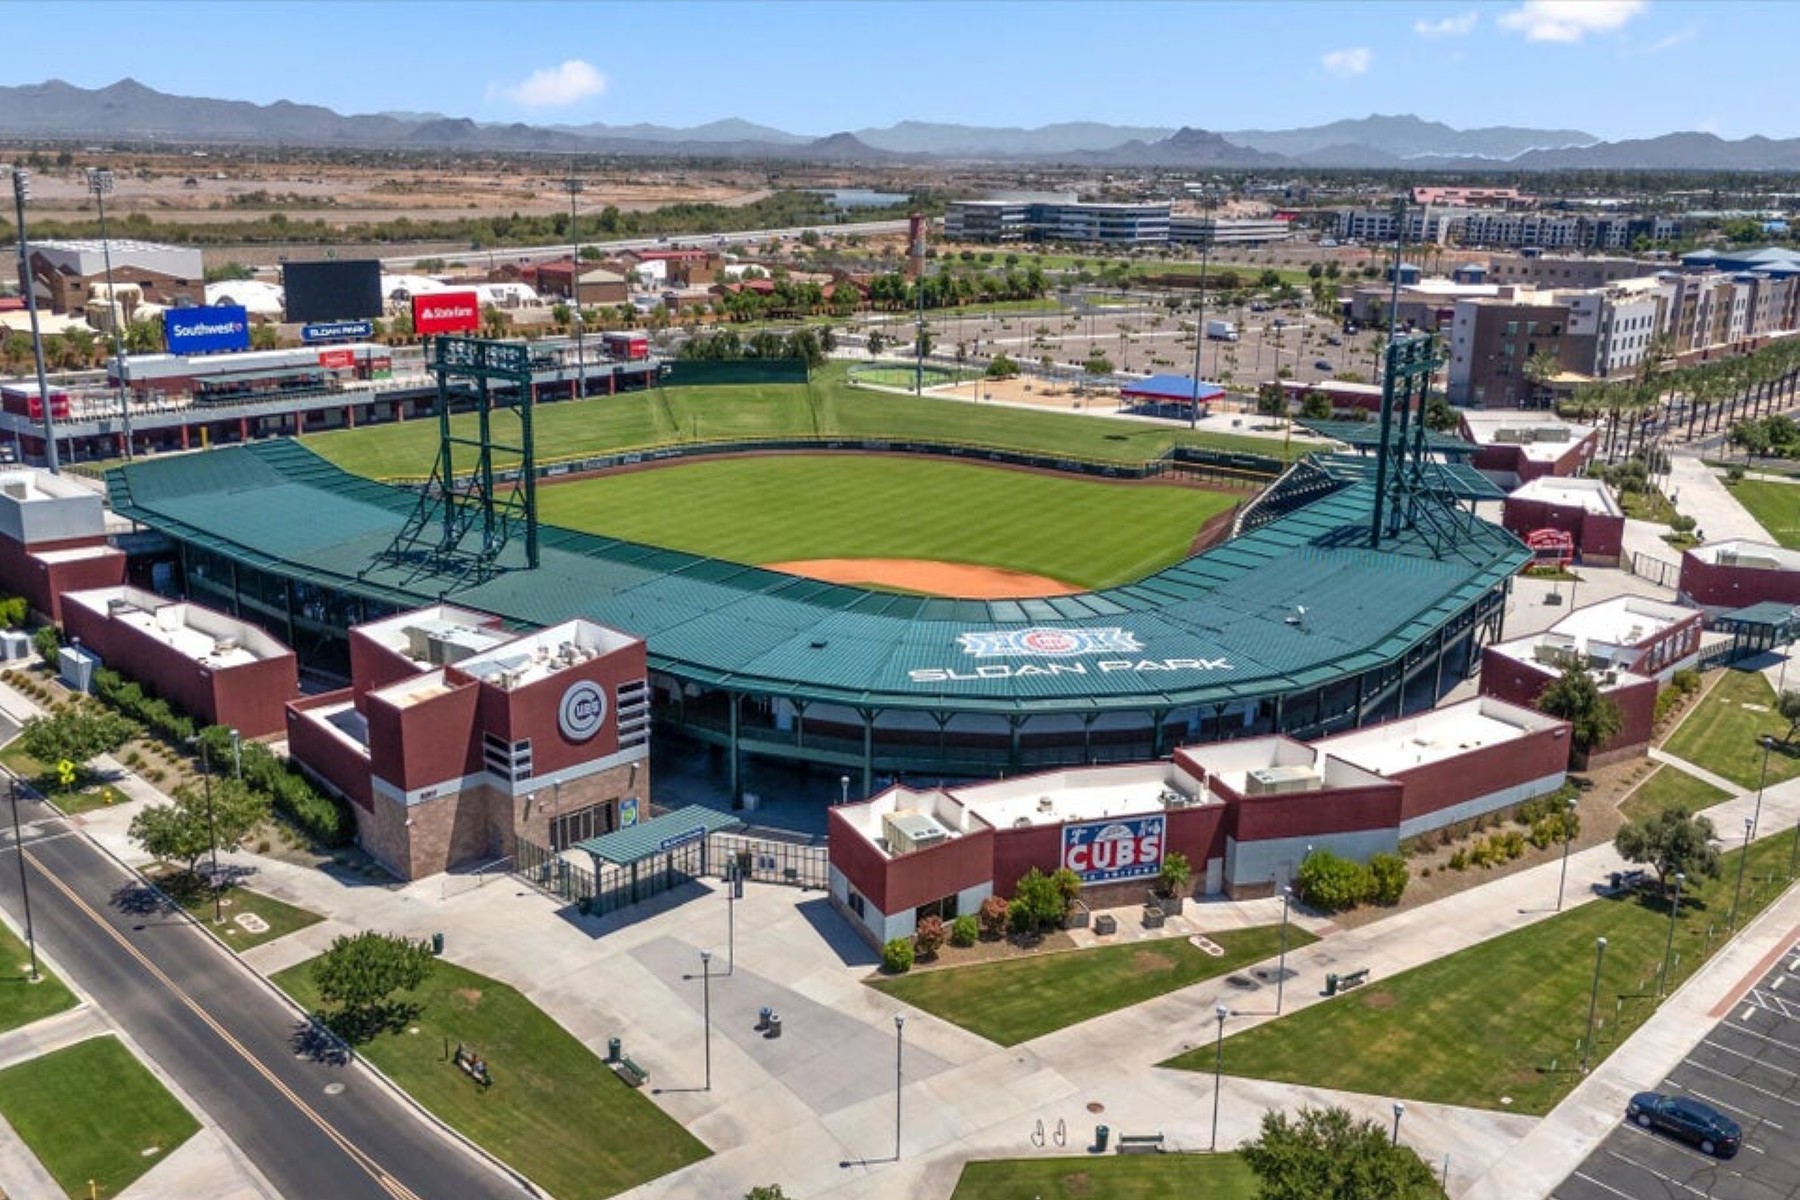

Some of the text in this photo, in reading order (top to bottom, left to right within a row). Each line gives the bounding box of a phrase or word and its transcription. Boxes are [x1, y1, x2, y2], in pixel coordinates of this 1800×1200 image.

[173, 322, 234, 337] Southwest
[908, 657, 1234, 682] SLOAN PARK
[1067, 835, 1159, 871] CUBS
